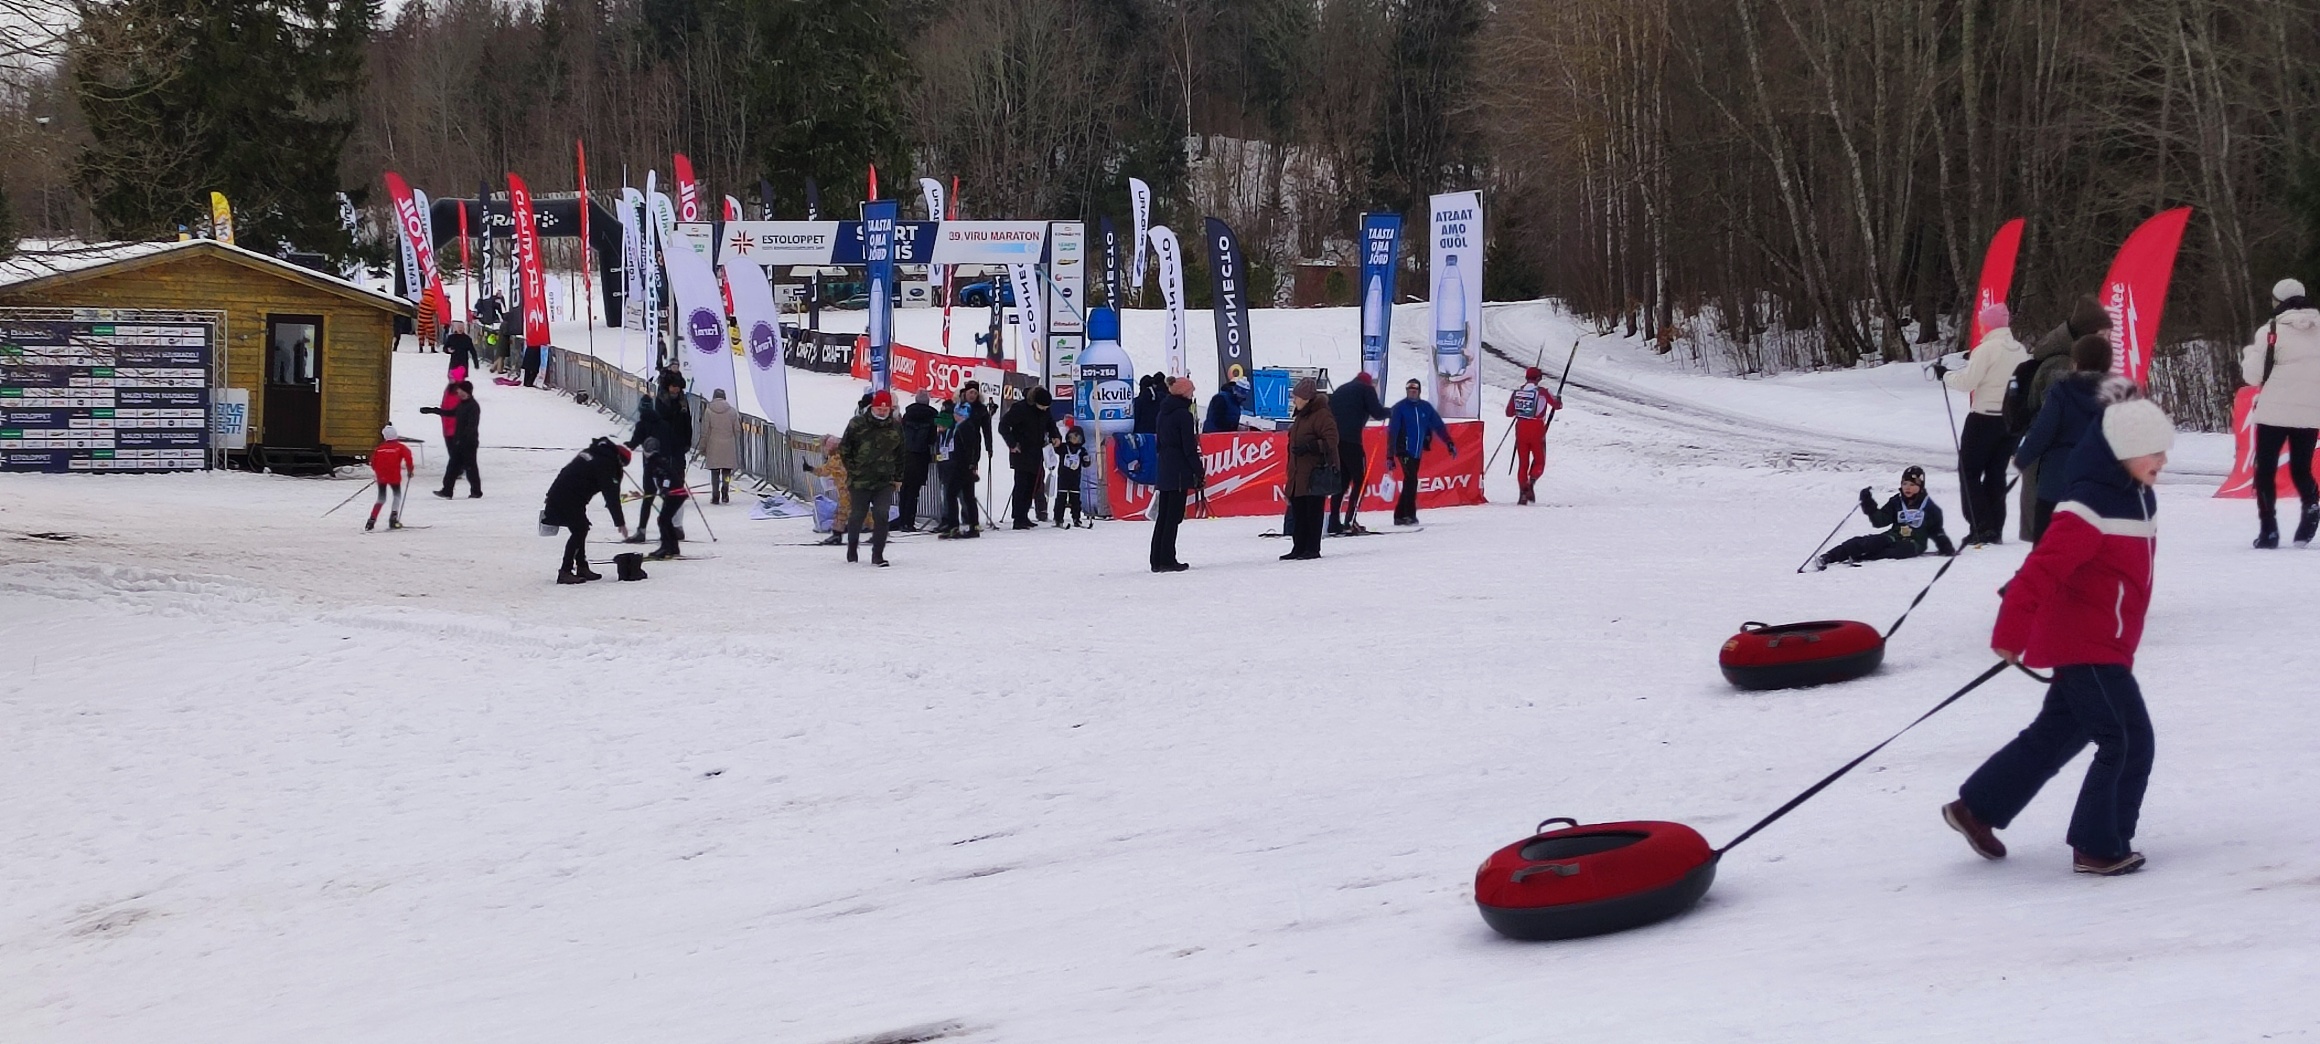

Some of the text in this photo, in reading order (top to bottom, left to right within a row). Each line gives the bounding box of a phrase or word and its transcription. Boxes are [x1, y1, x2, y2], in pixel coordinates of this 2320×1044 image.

[856, 225, 919, 241] SRT
[964, 232, 988, 241] VIRU
[991, 231, 1040, 241] MARATON
[762, 235, 825, 245] ESTOLOPPET
[1417, 474, 1472, 493] EAVY
